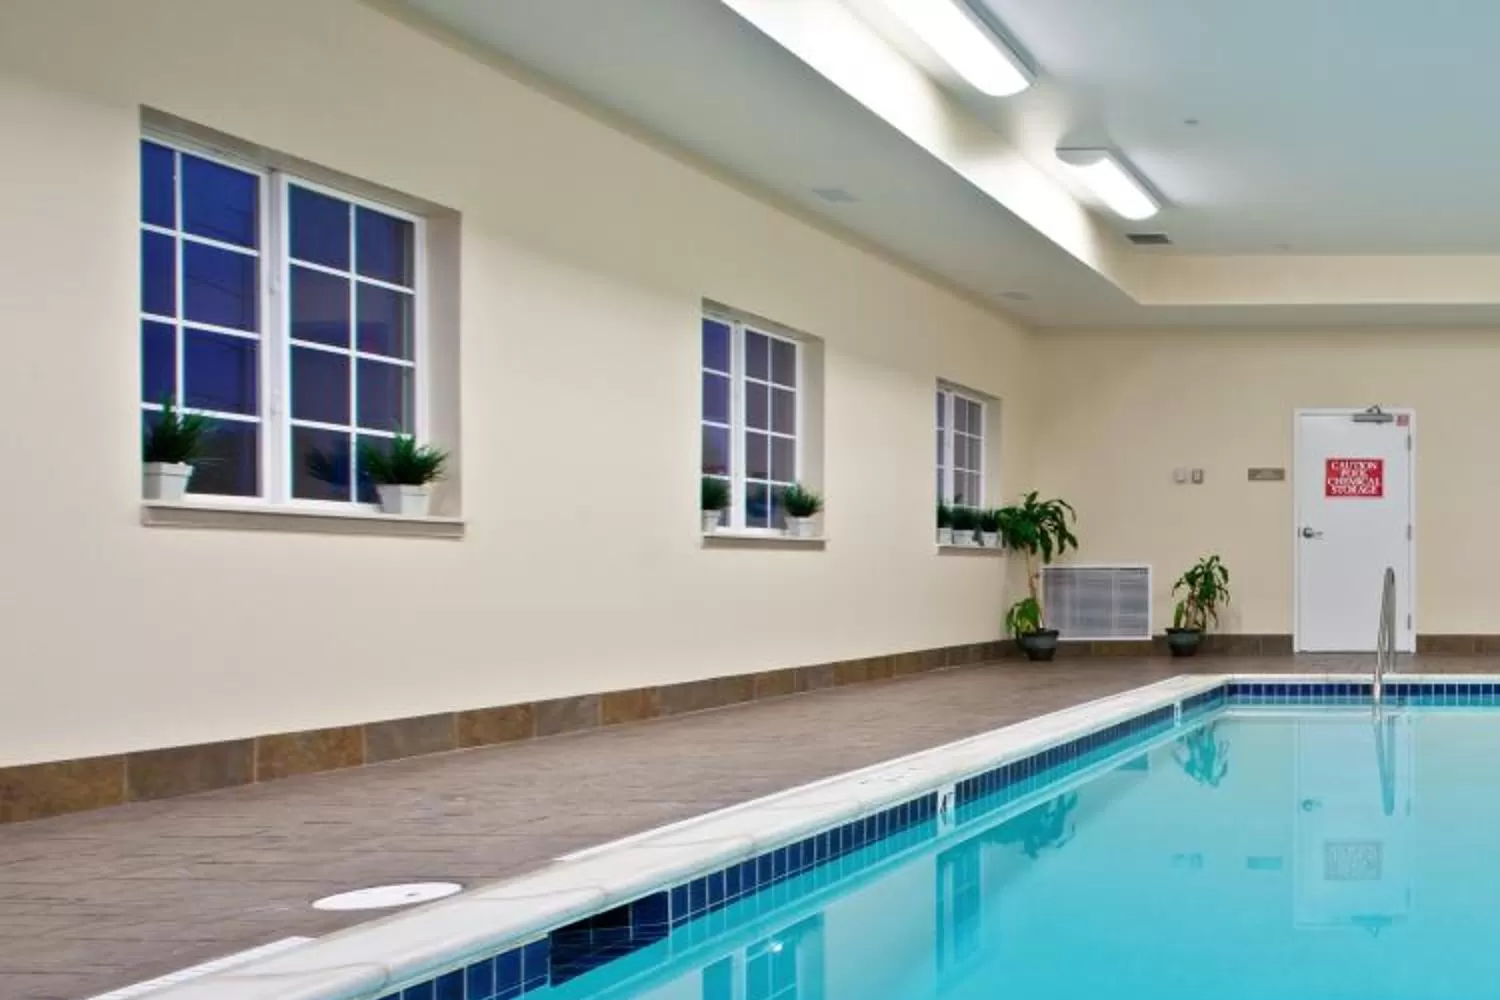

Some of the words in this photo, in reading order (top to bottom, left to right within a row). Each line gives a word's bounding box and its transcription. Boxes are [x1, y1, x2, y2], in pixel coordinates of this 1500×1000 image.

[1331, 460, 1378, 470] CAUTION
[1327, 477, 1381, 486] CHEMICAL
[1330, 485, 1378, 495] STORAGE
